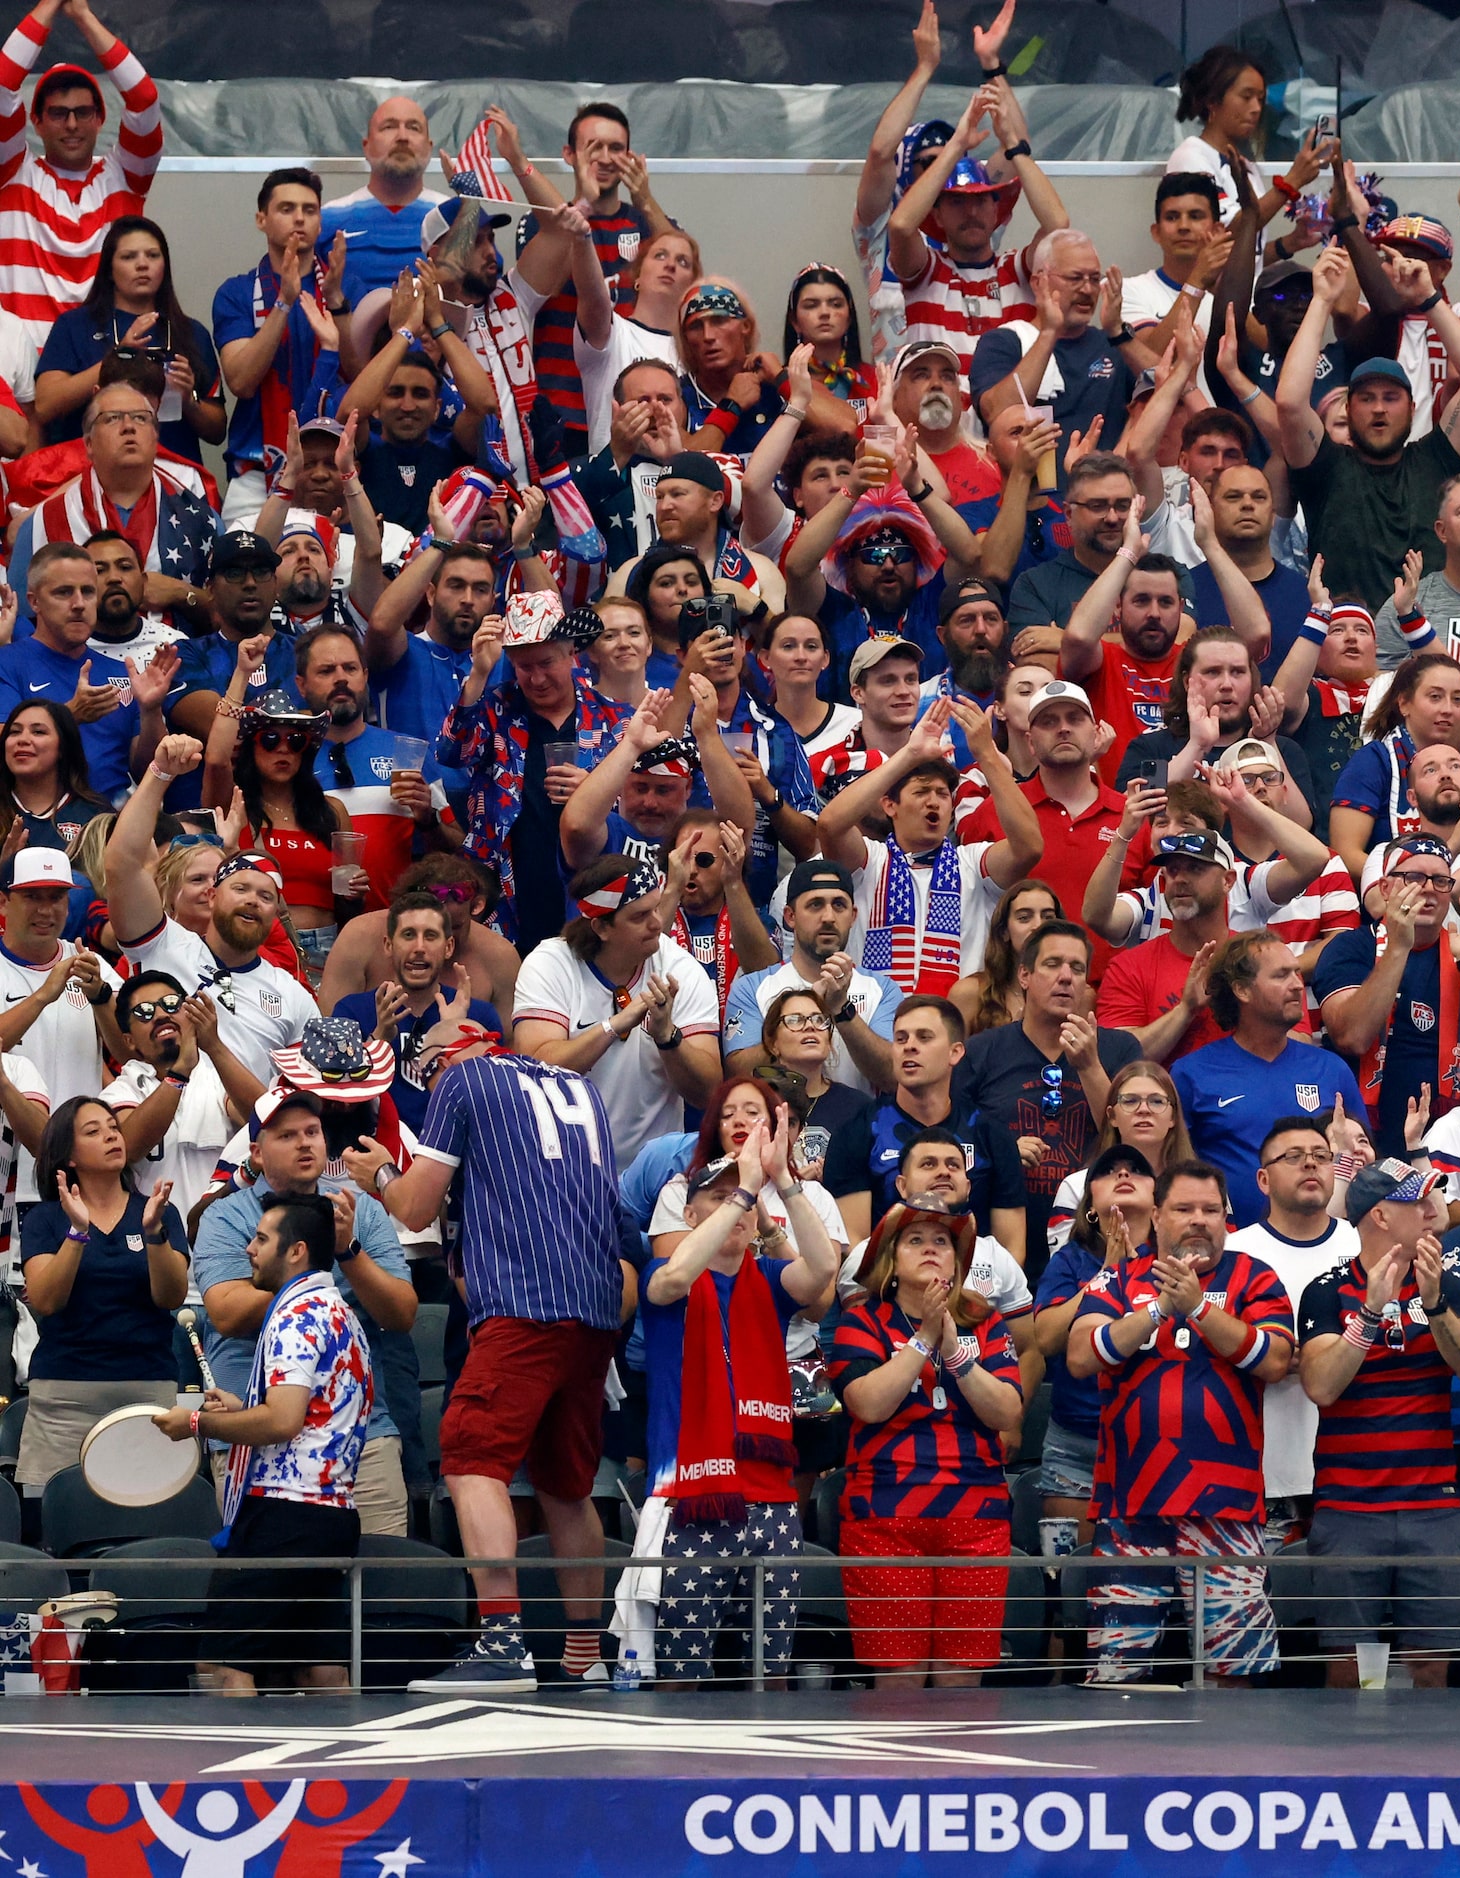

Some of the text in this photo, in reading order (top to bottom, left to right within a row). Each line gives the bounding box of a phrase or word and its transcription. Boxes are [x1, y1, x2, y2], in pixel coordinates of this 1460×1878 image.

[618, 233, 639, 245] USA
[1314, 356, 1331, 378] SA
[643, 477, 658, 488] US
[270, 837, 316, 849] USA
[717, 923, 727, 940] AND
[66, 981, 80, 994] US
[261, 992, 280, 1005] USA
[1297, 1083, 1317, 1095] USA
[519, 1074, 600, 1165] 14
[973, 1269, 990, 1280] USA
[1205, 1293, 1225, 1301] USA
[1408, 1299, 1422, 1309] US
[738, 1399, 790, 1424] MEMBER
[680, 1458, 736, 1482] MEMBER
[685, 1792, 1128, 1855] CONMEBOL
[1145, 1791, 1357, 1851] COPA
